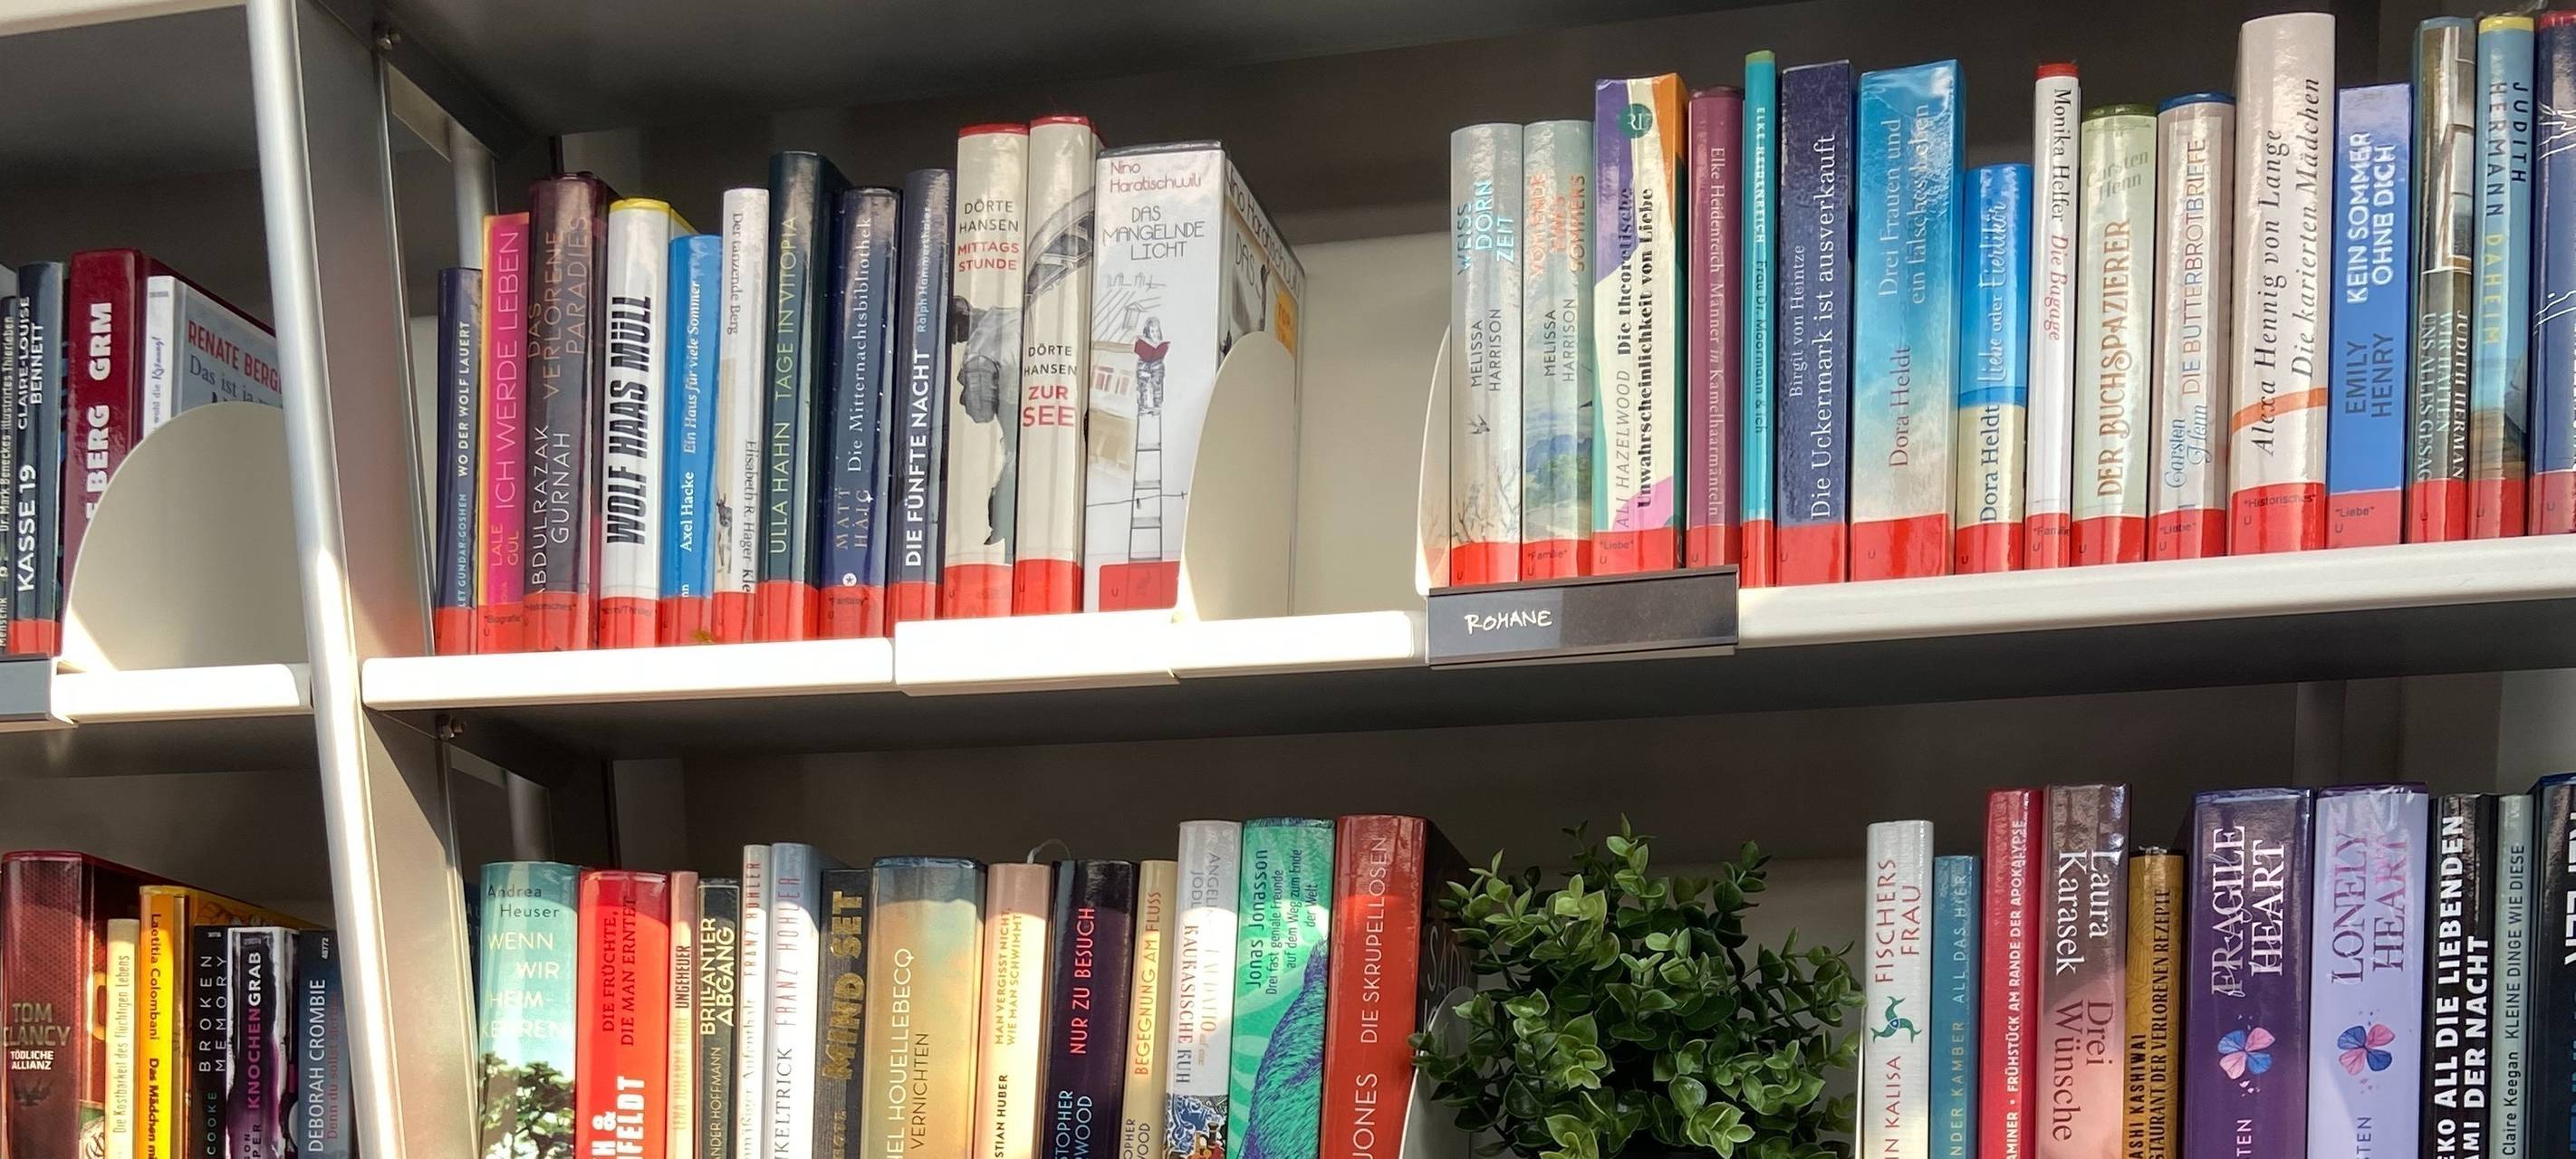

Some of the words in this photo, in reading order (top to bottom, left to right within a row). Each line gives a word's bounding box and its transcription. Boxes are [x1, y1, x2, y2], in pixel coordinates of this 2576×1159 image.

[1710, 147, 1725, 180] Elke
[2294, 77, 2321, 197] Mädchen
[2485, 81, 2508, 218] HERMANN
[2511, 81, 2530, 184] JUDITH
[1110, 159, 1141, 176] Nino
[2257, 128, 2290, 208] Lange
[2347, 132, 2372, 241] SOMMER
[2373, 144, 2397, 207] DICH
[732, 212, 745, 238] Der
[958, 217, 1019, 235] HANSEN
[964, 198, 1014, 216] DÖRTE
[1102, 220, 1206, 247] MANGELNDE
[1130, 205, 1161, 223] DAS
[1474, 181, 1493, 250] DORN
[1570, 175, 1586, 273] SOMMERS
[1709, 184, 1725, 273] Heidenreich
[1812, 133, 1837, 283] ausverkauft
[957, 240, 1020, 256] MITTAGS
[958, 258, 1017, 273] STUNDE
[1130, 240, 1187, 261] LICHT
[1496, 215, 1514, 263] ZEIT
[2261, 220, 2283, 265] von
[2291, 204, 2319, 324] karierten
[2370, 212, 2393, 285] OHNE
[496, 231, 520, 330] LEBEN
[730, 240, 744, 302] tanzende
[1791, 244, 1807, 310] Heintze
[2346, 244, 2369, 303] KEIN
[527, 302, 542, 359] DAS
[687, 280, 701, 335] Sommer
[727, 304, 741, 335] Berg
[849, 216, 872, 433] Mitternachtsbibliothek
[1708, 282, 1724, 344] Männer
[1793, 314, 1806, 346] von
[1813, 291, 1834, 322] ist
[2098, 217, 2132, 440] BUCHSPAZIERER
[2253, 273, 2288, 369] Hennig
[2438, 311, 2454, 350] WIR
[17, 297, 30, 430] CLAIRE-LOUISE
[30, 322, 44, 405] BENNETT
[89, 302, 112, 381] GRM
[458, 321, 472, 375] LAUERT
[687, 337, 700, 369] viele
[1023, 362, 1078, 378] HANSEN
[1028, 342, 1072, 358] DÖRTE
[1470, 319, 1484, 388] MELISSA
[1487, 307, 1503, 392] HARRISON
[1543, 309, 1557, 378] MELISSA
[1561, 297, 1576, 383] HARRISON
[1708, 348, 1723, 364] in
[2290, 331, 2315, 381] Die
[2454, 309, 2468, 386] JUDITH
[457, 378, 471, 417] WOLF
[495, 340, 518, 452] WERDE
[686, 369, 702, 394] für
[909, 348, 931, 429] NACHT
[1028, 384, 1069, 401] ZUR
[1789, 350, 1808, 398] Birgit
[1811, 330, 1834, 470] Uckermark
[1889, 346, 1912, 408] Heldt
[2345, 340, 2368, 414] EMILY
[2370, 332, 2395, 417] HENRY
[2437, 356, 2453, 434] HÄTTEN
[457, 419, 470, 450] DER
[683, 432, 697, 455] Ein
[684, 396, 698, 429] Haus
[1021, 404, 1076, 428] SEE
[1615, 369, 1631, 489] HAZELWOOD
[1707, 368, 1723, 517] Kamelhaarmänteln
[1889, 415, 1910, 468] Dora
[1979, 404, 2001, 465] Heldt
[2252, 380, 2278, 457] Alexa
[18, 464, 37, 493] 19
[87, 405, 111, 493] BERG
[457, 451, 470, 477] WO
[771, 421, 792, 492] HAHN
[847, 438, 864, 472] Die
[903, 435, 928, 523] FÜNFTE
[2097, 446, 2124, 497] DER
[495, 460, 516, 509] ICH
[551, 433, 571, 544] GURNAH
[681, 471, 696, 517] Hacke
[1615, 493, 1630, 529] ALI
[1810, 476, 1832, 519] Die
[1979, 471, 1998, 523] Dora
[18, 500, 36, 591] KASSE
[457, 493, 468, 587] GUNDAR-GOSHEN
[490, 522, 504, 566] LALE
[679, 519, 693, 551] Axel
[770, 497, 790, 554] ULLA
[835, 485, 851, 551] MATT
[905, 530, 924, 567] DIE
[487, 883, 542, 898] Andrea
[1248, 848, 1269, 932] Jonasson
[2010, 819, 2026, 906] APOKALYPSE
[2509, 845, 2524, 891] DIESE
[500, 903, 560, 918] Heuser
[621, 895, 638, 965] ERNTET
[1360, 835, 1389, 1003] SKRUPELLOSEN
[1874, 858, 1898, 982] FISCHERS
[1900, 884, 1921, 956] FRAU
[2009, 910, 2023, 937] DER
[2054, 848, 2088, 975] Karasek
[2210, 825, 2246, 996] FRAGILE
[2249, 839, 2285, 977] HEART
[2331, 829, 2368, 983] LONELY
[2373, 833, 2407, 972] HEART
[2437, 815, 2465, 986] LIEBENDEN
[2508, 896, 2523, 925] WIE
[150, 913, 162, 963] Laetitia
[487, 931, 554, 951] WENN
[1073, 907, 1097, 978] BESUCH
[1246, 939, 1264, 989] Jonas
[2008, 941, 2022, 987] RANDE
[2507, 929, 2523, 977] DINGE
[149, 966, 162, 1040] Colombani
[621, 969, 636, 1012] MAN
[674, 944, 691, 1009] UNGEHEUER
[699, 917, 716, 1036] BRILLANTER
[716, 925, 735, 1028] ABGANG
[1072, 986, 1091, 1011] ZU
[2008, 991, 2021, 1012] AM
[2465, 935, 2489, 1039] NACHT
[12, 1001, 53, 1024] TOM
[198, 955, 213, 1073] BROKEN
[215, 955, 227, 1072] MEMORY
[247, 952, 262, 1109] KNOCHENGRAB
[309, 978, 326, 1062] CROMBIE
[620, 1018, 636, 1047] DIE
[888, 948, 914, 1121] HOUELLEBECQ
[1070, 1017, 1089, 1055] NUR
[1359, 1010, 1380, 1044] DIE
[2085, 999, 2113, 1065] Drei
[2435, 997, 2459, 1049] DIE
[2505, 982, 2521, 1039] KLEINE
[10, 1049, 54, 1061] TÖDLICHE
[11, 1059, 53, 1071] ALLIANZ
[710, 1047, 723, 1119] HOFFMANN
[1950, 1021, 1965, 1097] KAMBER
[2004, 1016, 2020, 1093] FRÜHSTÜCK
[2051, 999, 2084, 1141] Wünsche
[2434, 1055, 2458, 1108] ALL
[2463, 1048, 2486, 1109] DER
[308, 1067, 325, 1153] DEBORAH
[910, 1031, 928, 1151] VERNICHTEN
[995, 1074, 1008, 1118] HUBER
[1884, 1056, 1901, 1128] KALISA
